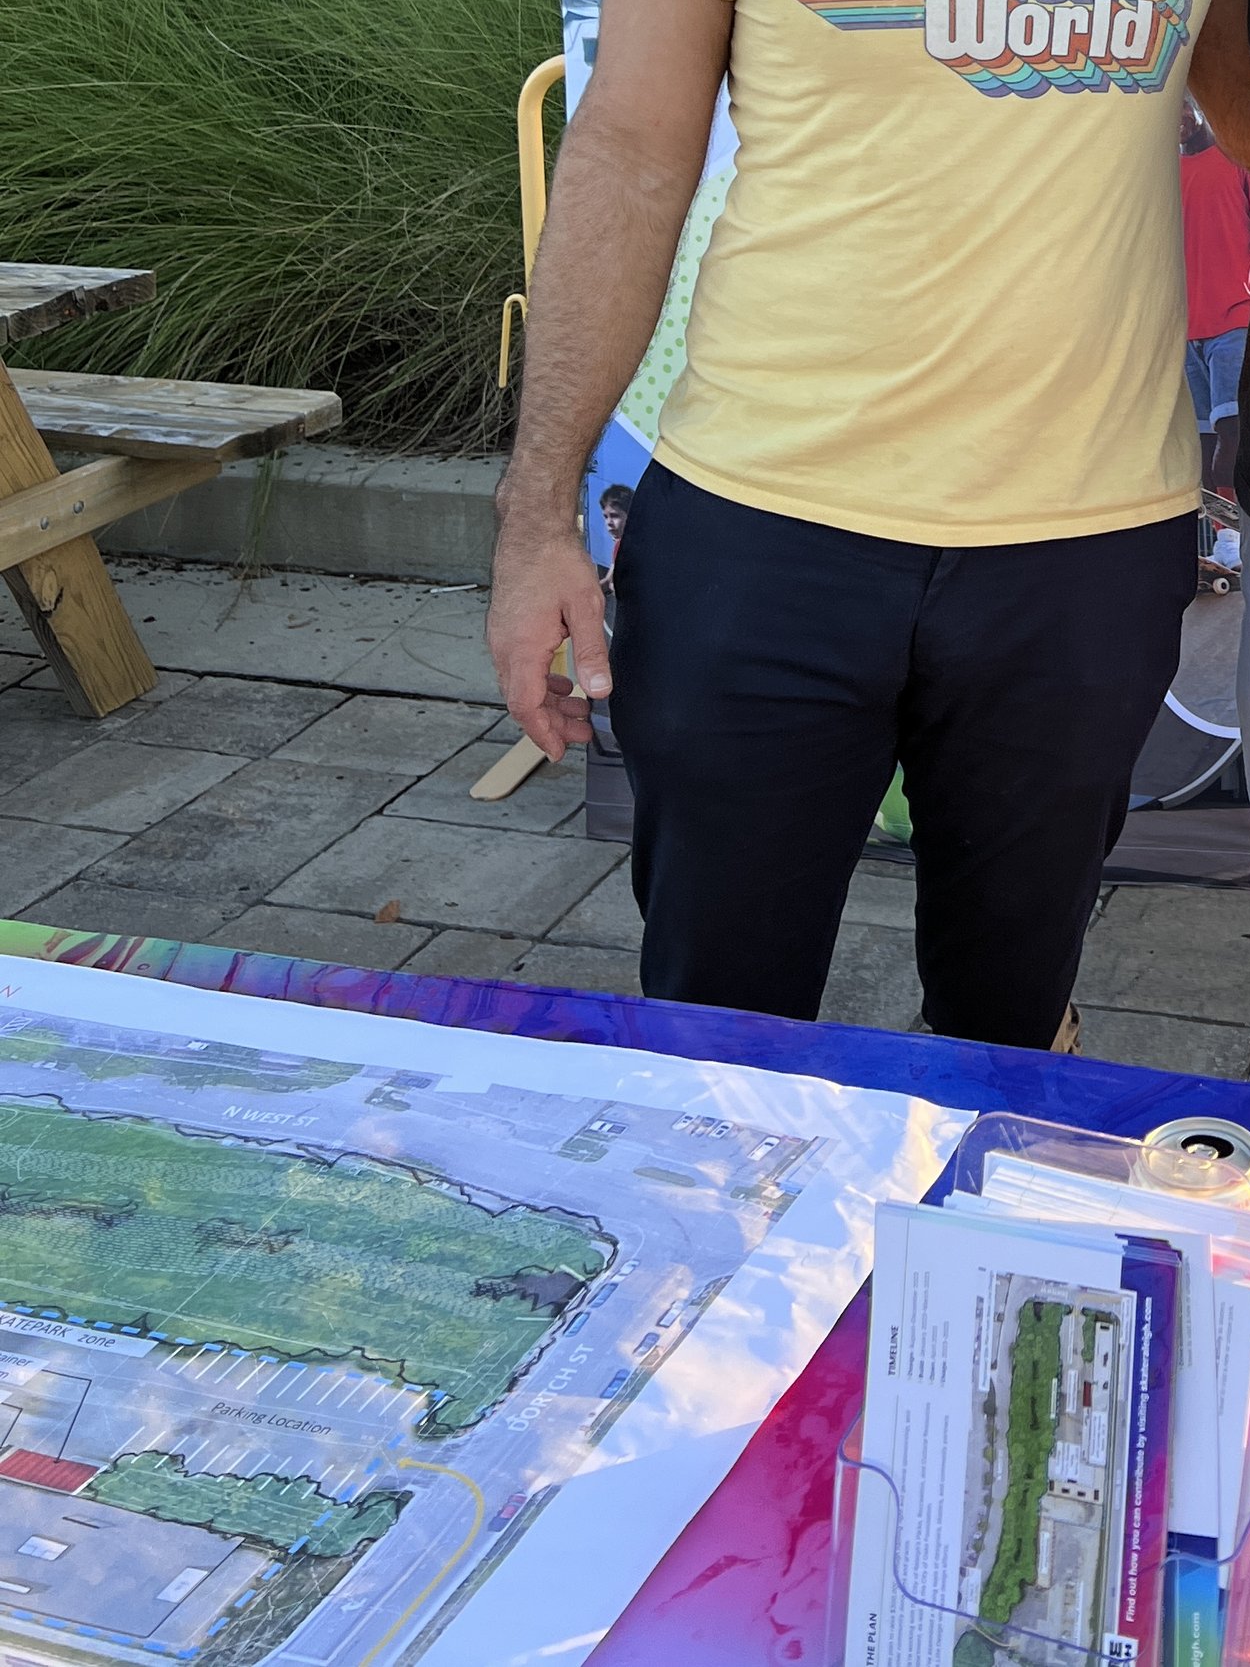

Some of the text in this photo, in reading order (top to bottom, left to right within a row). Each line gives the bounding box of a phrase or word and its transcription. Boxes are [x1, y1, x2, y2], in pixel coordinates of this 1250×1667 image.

[223, 1105, 319, 1127] N WEST ST
[0, 1314, 116, 1348] KATEPARK zone
[887, 1325, 899, 1376] TIMELINE
[507, 1343, 595, 1434] DORTCH ST
[211, 1401, 332, 1436] Parking Location
[1125, 1296, 1153, 1623] Find out how you can contribute by visiting skateraleigh.com
[866, 1613, 878, 1667] THE PLAN
